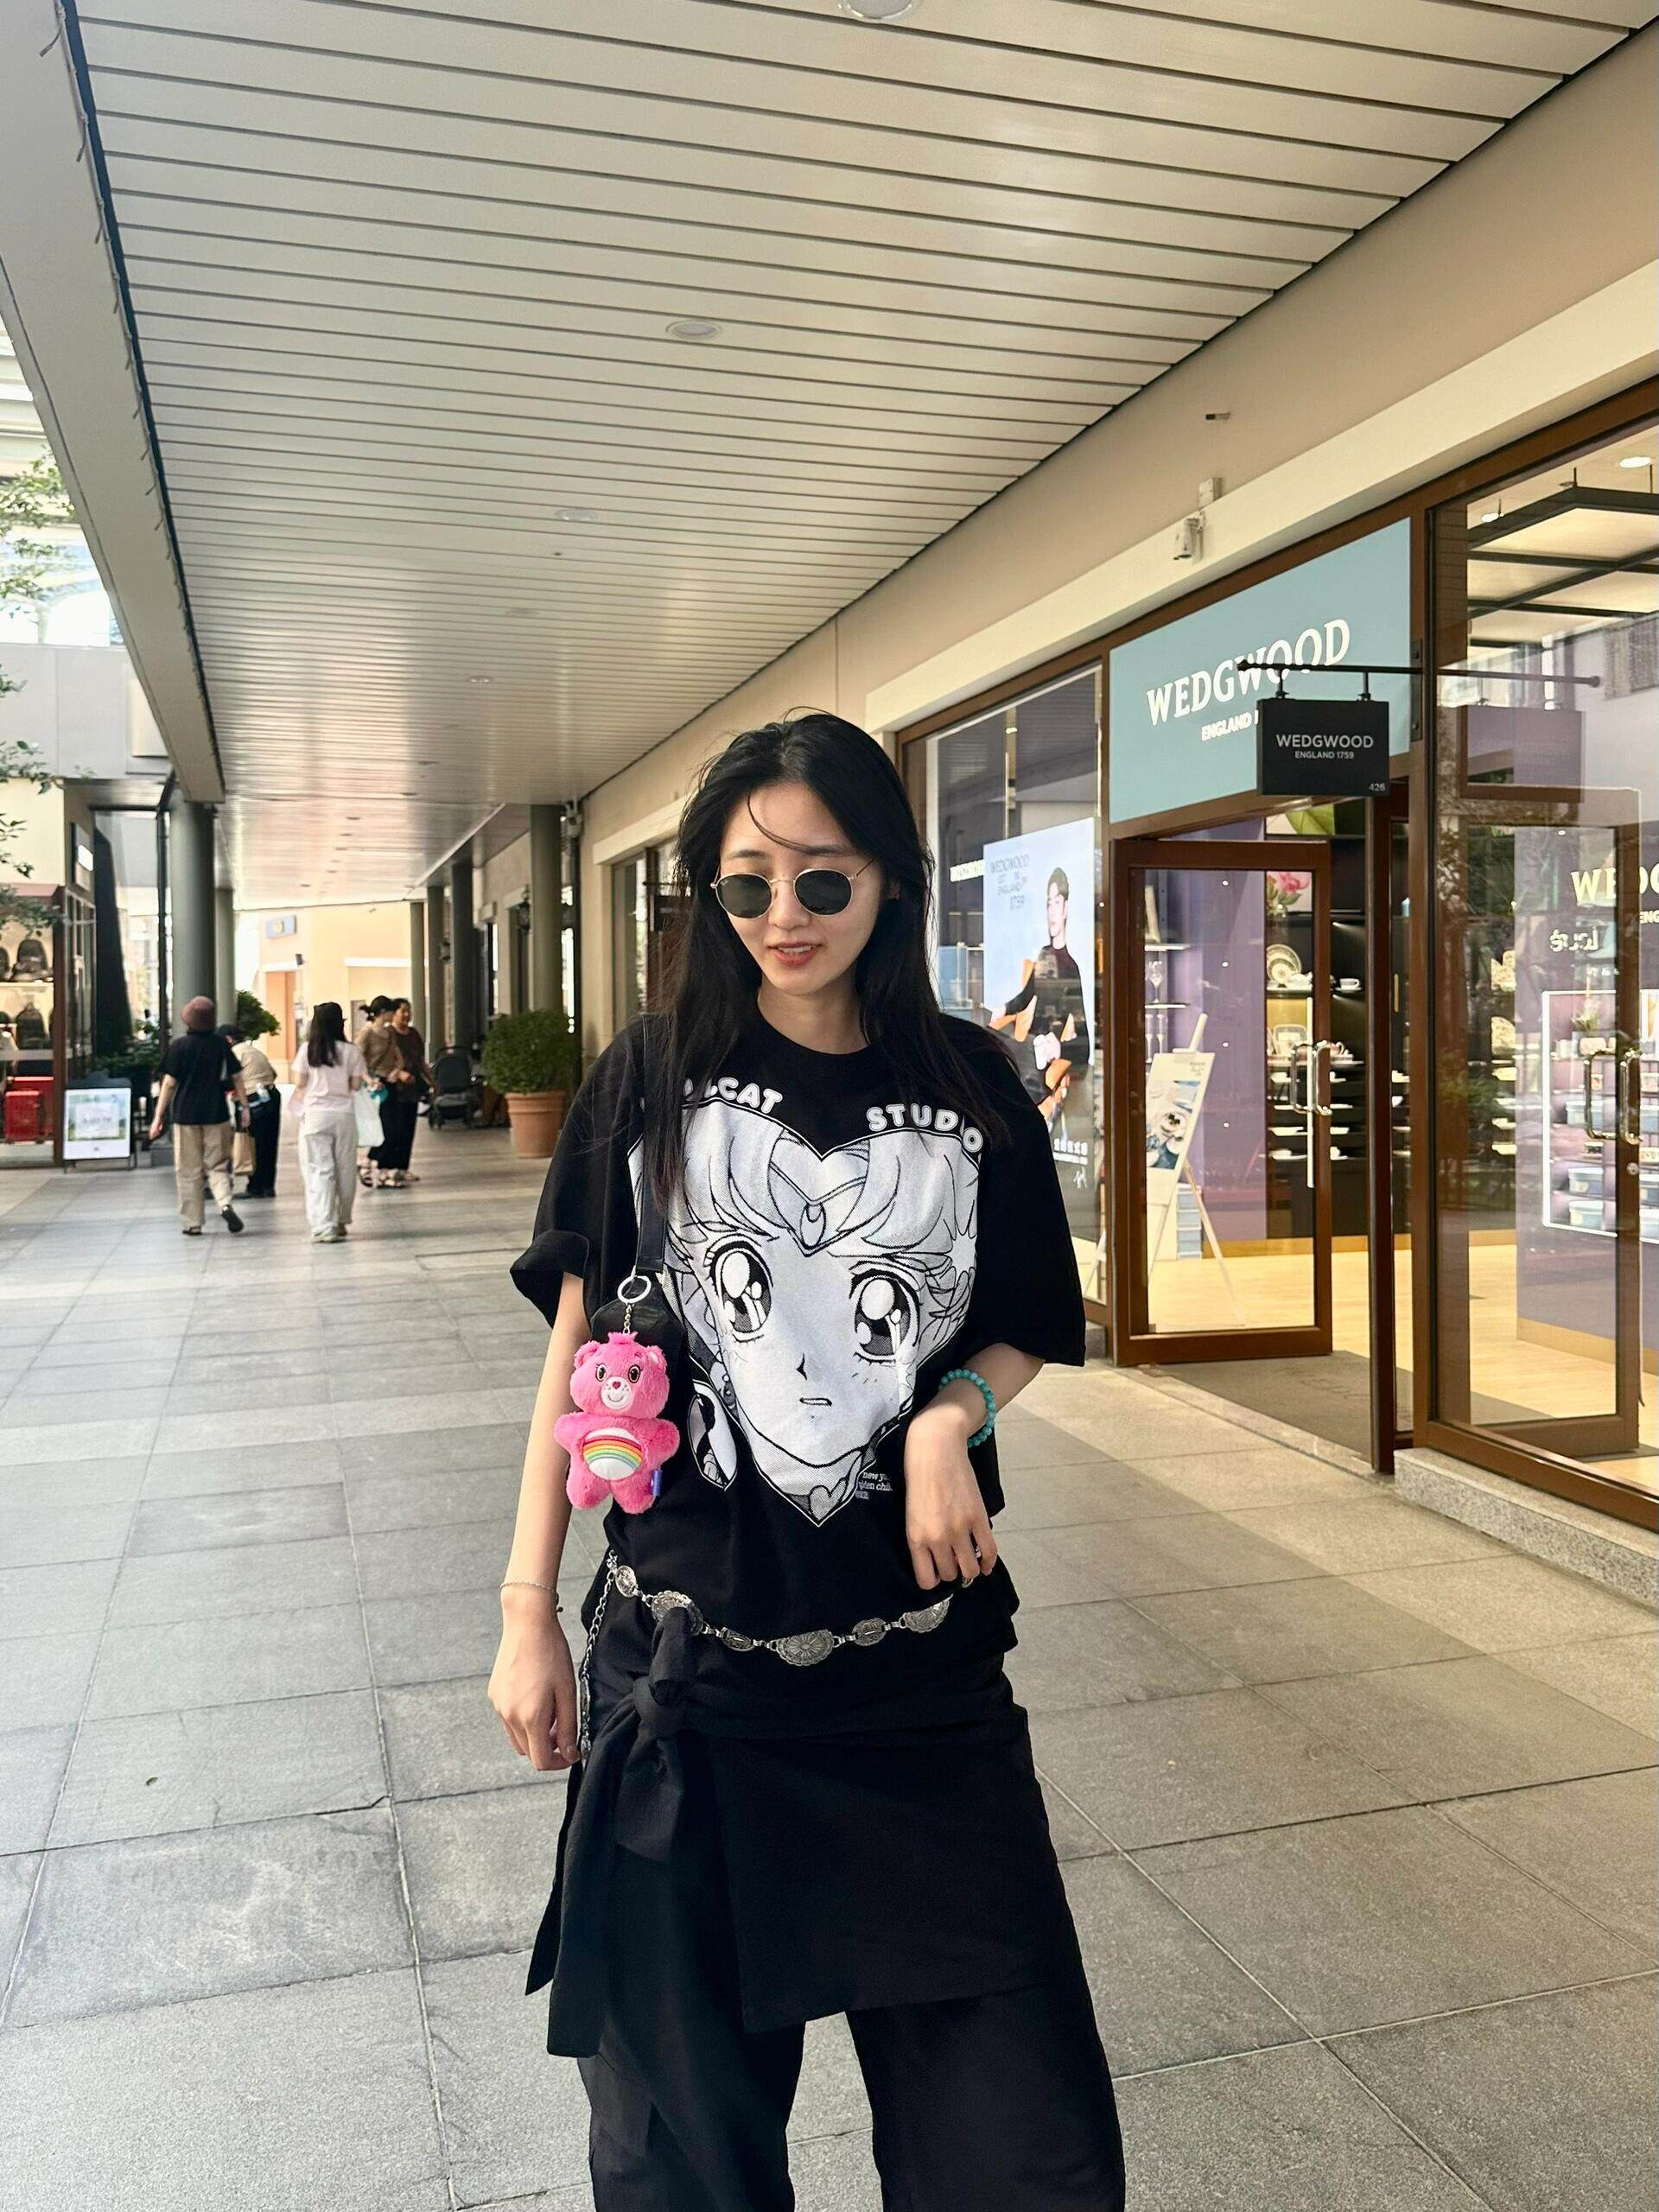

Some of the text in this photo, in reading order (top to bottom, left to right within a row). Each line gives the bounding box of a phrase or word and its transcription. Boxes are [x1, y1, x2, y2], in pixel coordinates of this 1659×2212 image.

[1146, 619, 1351, 726] WEDGWOOD
[1201, 711, 1252, 741] ENGLAND
[1276, 734, 1374, 748] WEDGWOOD
[1294, 750, 1355, 760] ENGLAND 1759
